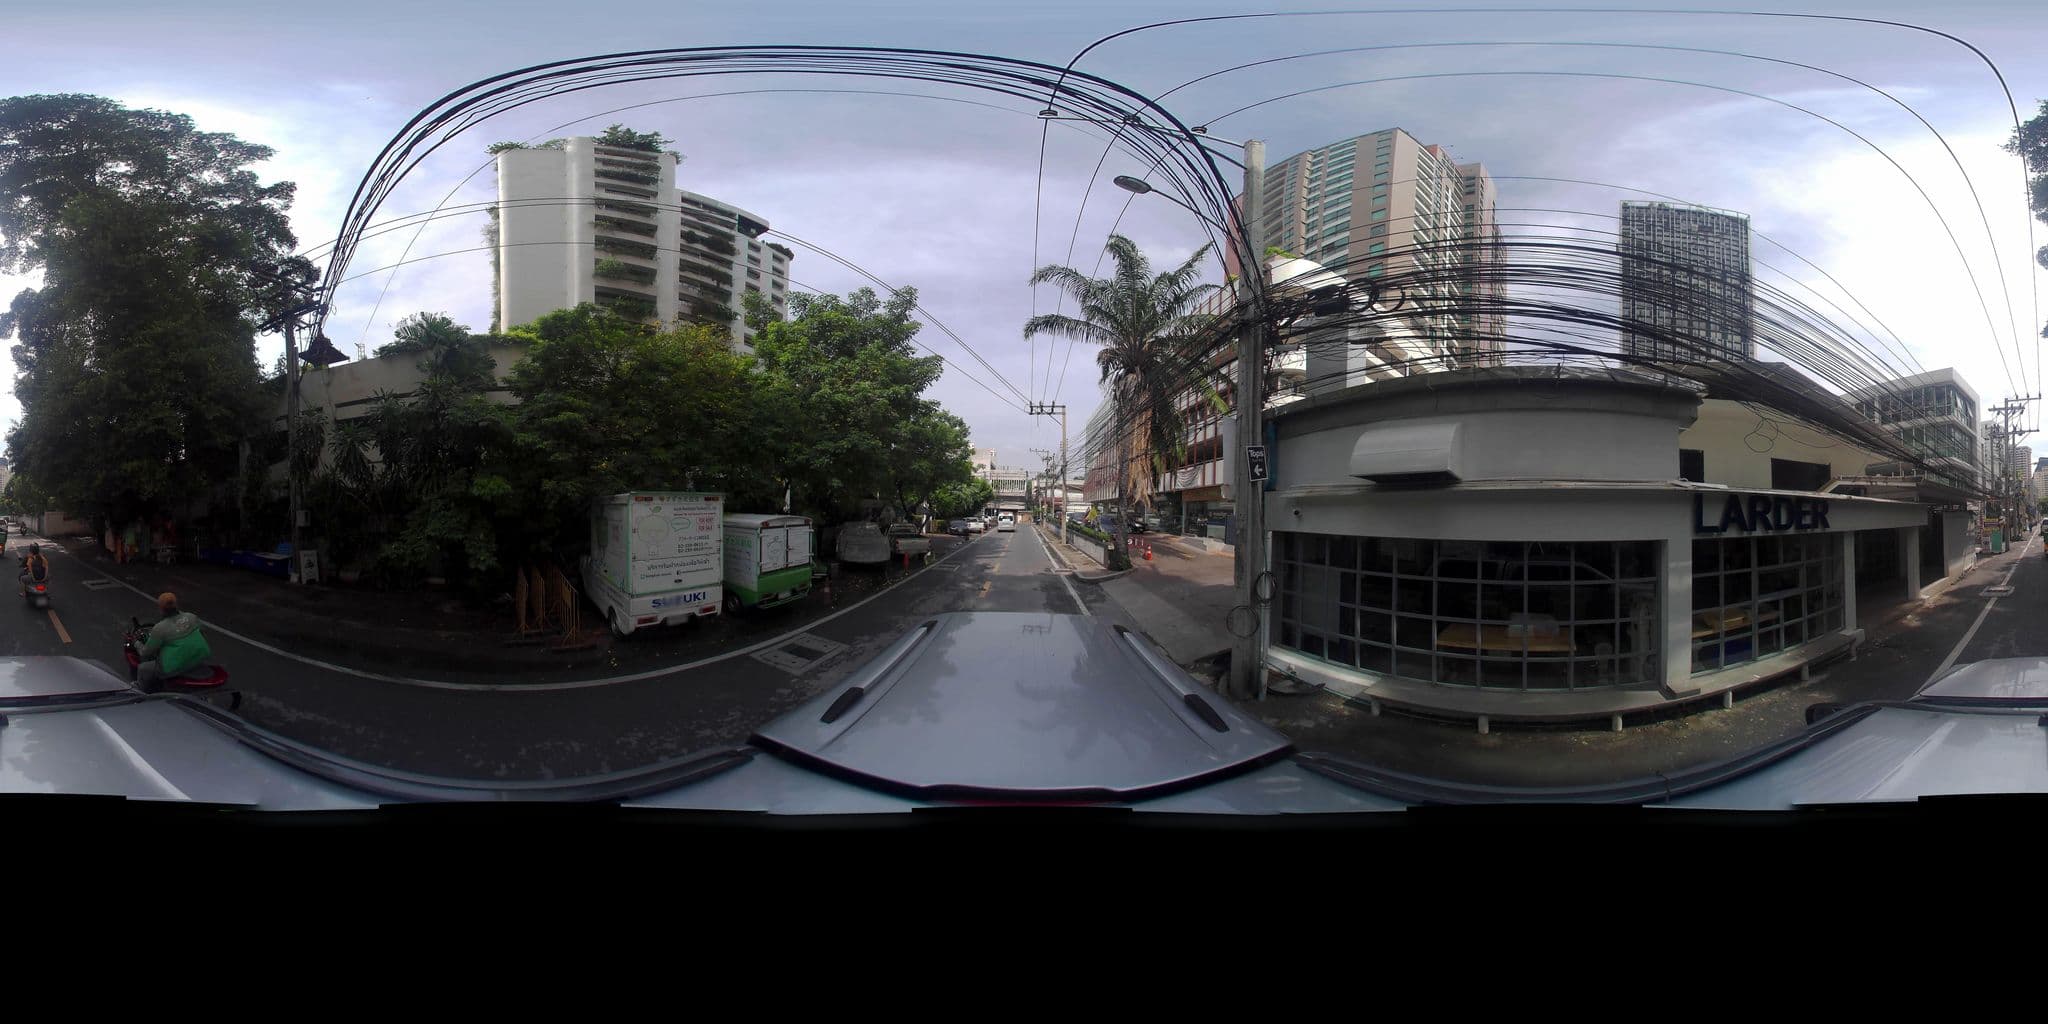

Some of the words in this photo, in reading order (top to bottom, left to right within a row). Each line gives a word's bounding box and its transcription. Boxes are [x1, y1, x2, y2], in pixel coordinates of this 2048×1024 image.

[1249, 449, 1264, 458] Tops
[1694, 493, 1830, 533] LARDER
[651, 591, 706, 608] SUKI
